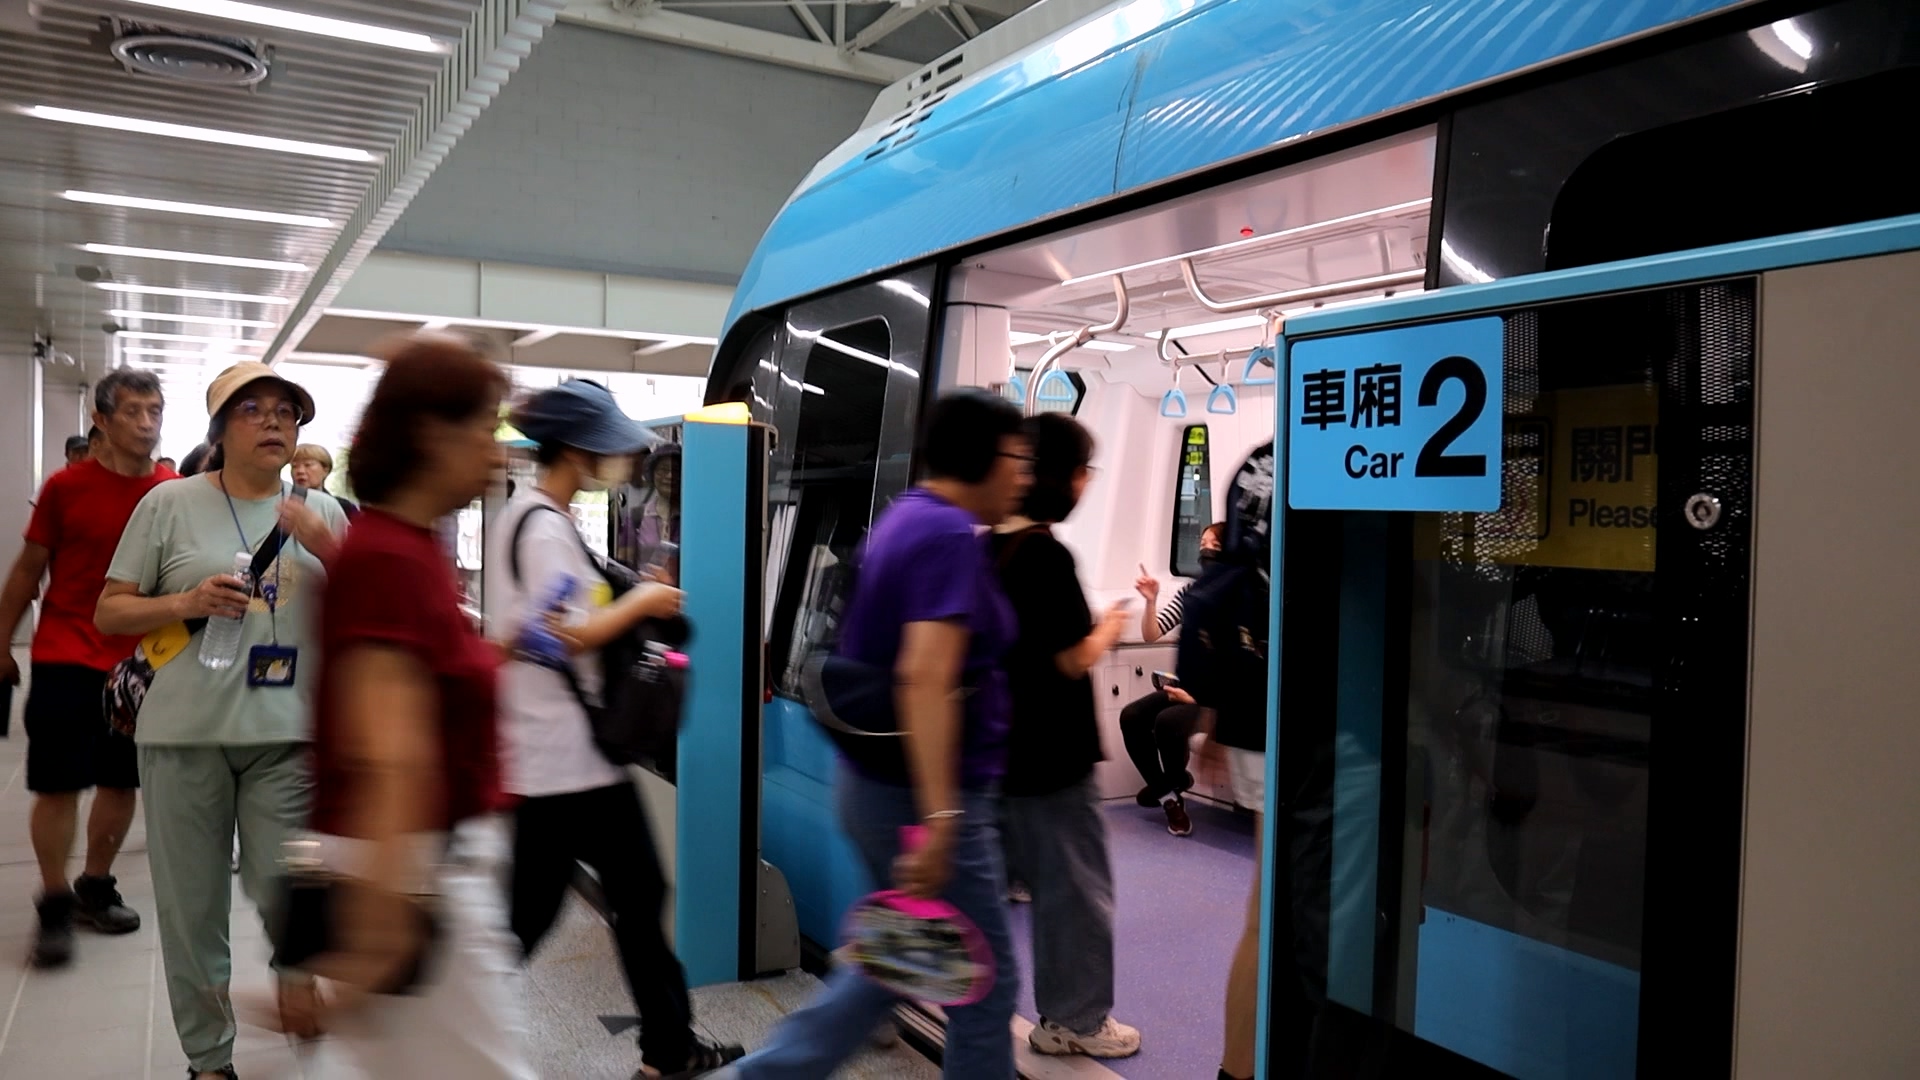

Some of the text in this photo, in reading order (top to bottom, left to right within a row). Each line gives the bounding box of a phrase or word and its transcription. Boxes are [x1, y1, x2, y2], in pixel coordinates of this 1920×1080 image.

[1301, 356, 1487, 477] 車廂 2
[1345, 445, 1404, 478] Car
